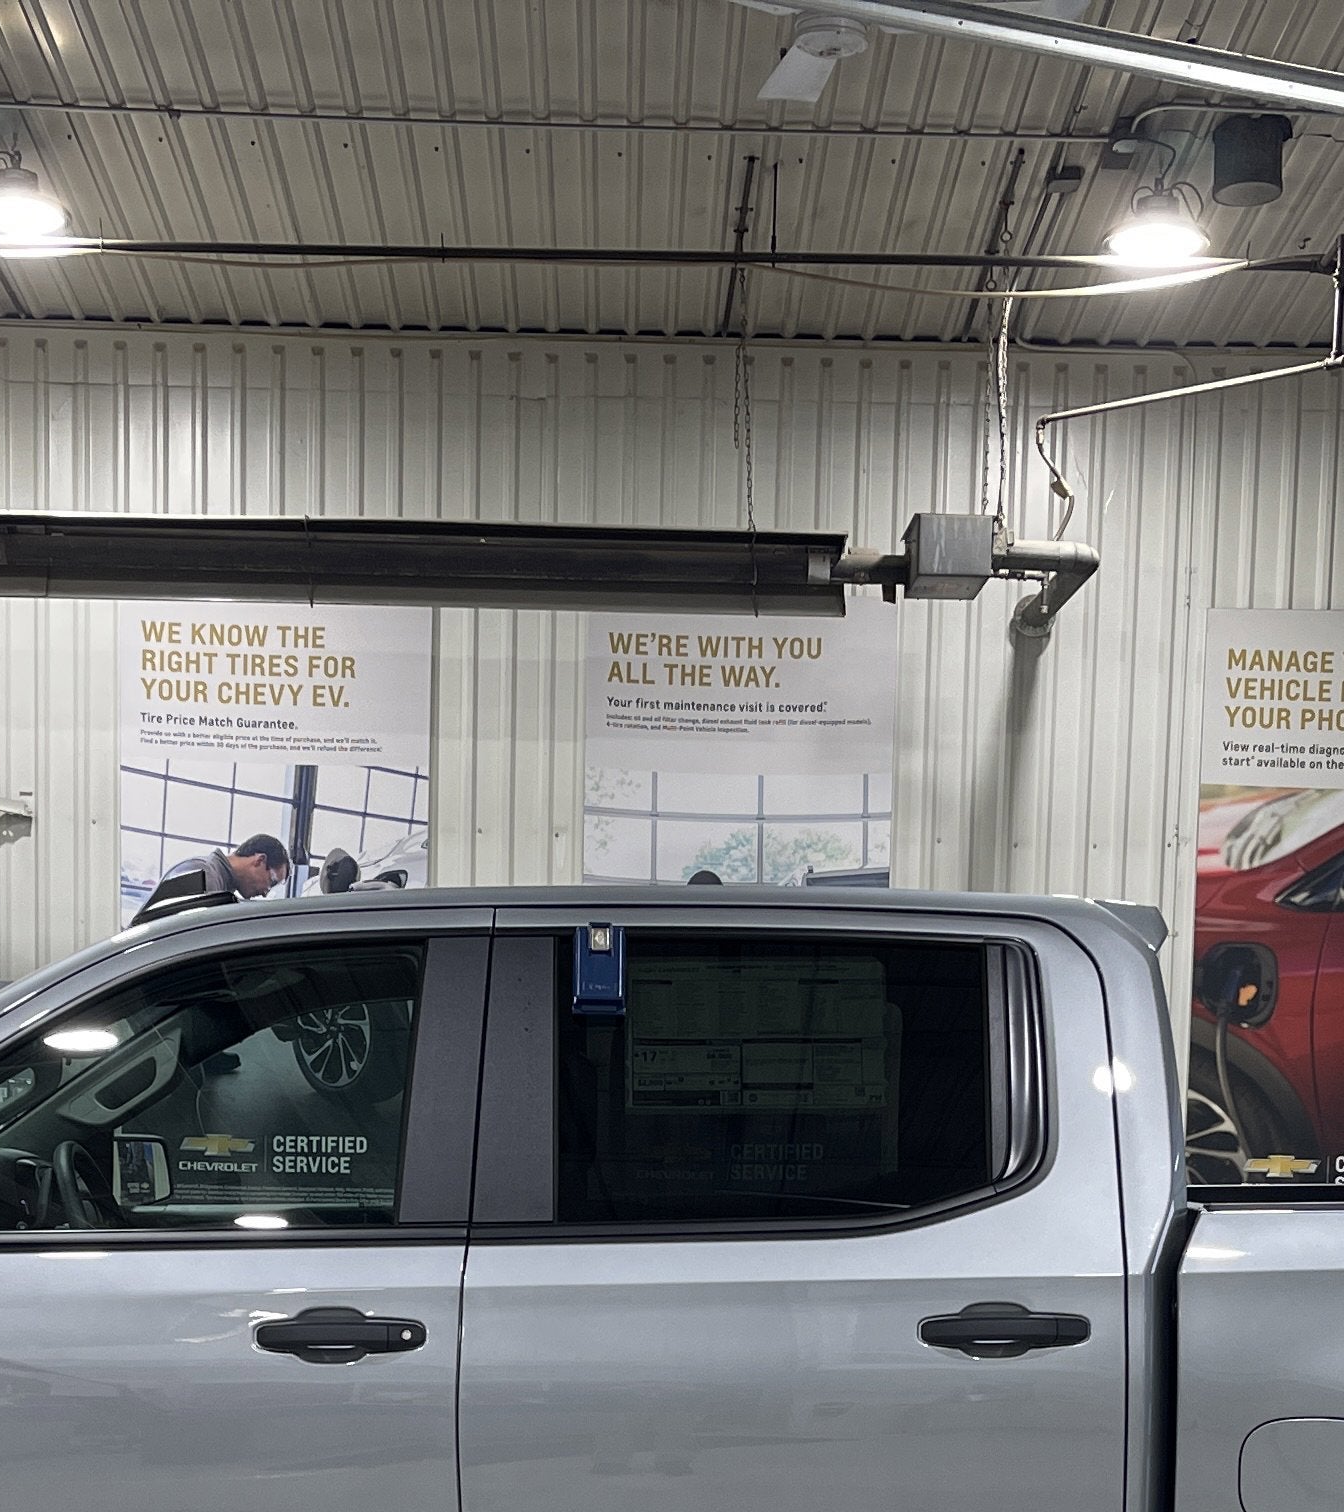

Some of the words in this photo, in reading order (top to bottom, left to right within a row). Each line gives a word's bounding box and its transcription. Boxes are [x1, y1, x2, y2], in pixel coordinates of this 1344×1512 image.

[141, 620, 182, 643] WE
[191, 623, 268, 647] KNOW
[277, 625, 326, 649] THE
[609, 632, 689, 657] WE'RE
[698, 635, 763, 659] WITH
[772, 637, 822, 660] YOU
[141, 649, 218, 675] RIGHT
[226, 653, 299, 677] TIRES
[308, 655, 356, 679] FOR
[1227, 648, 1333, 673] MANAGE
[607, 661, 655, 684] ALL
[664, 663, 712, 687] THE
[720, 665, 780, 688] WAY.
[140, 677, 208, 703] YOUR
[217, 682, 304, 706] CHEVY
[312, 684, 350, 708] EV.
[1226, 677, 1332, 702] VEHICLE
[607, 696, 632, 708] Your
[636, 698, 660, 710] first
[663, 700, 736, 712] maintenance
[739, 701, 762, 712] visit
[766, 701, 775, 712] is
[140, 712, 162, 724] Tire
[166, 714, 196, 725] Price
[199, 715, 233, 727] Match
[237, 717, 298, 730] Guarantee.
[1224, 705, 1291, 730] YOUR
[1222, 740, 1249, 752] View
[1253, 742, 1306, 754] real-time
[1256, 757, 1306, 768] available
[1309, 761, 1322, 769] on
[1326, 759, 1344, 769] the
[272, 1136, 367, 1154] CERTIFIED
[730, 1143, 823, 1160] CERTIFIED
[178, 1161, 258, 1173] CHEVROLET
[272, 1156, 350, 1174] SERVICE
[730, 1164, 807, 1180] SERVICE
